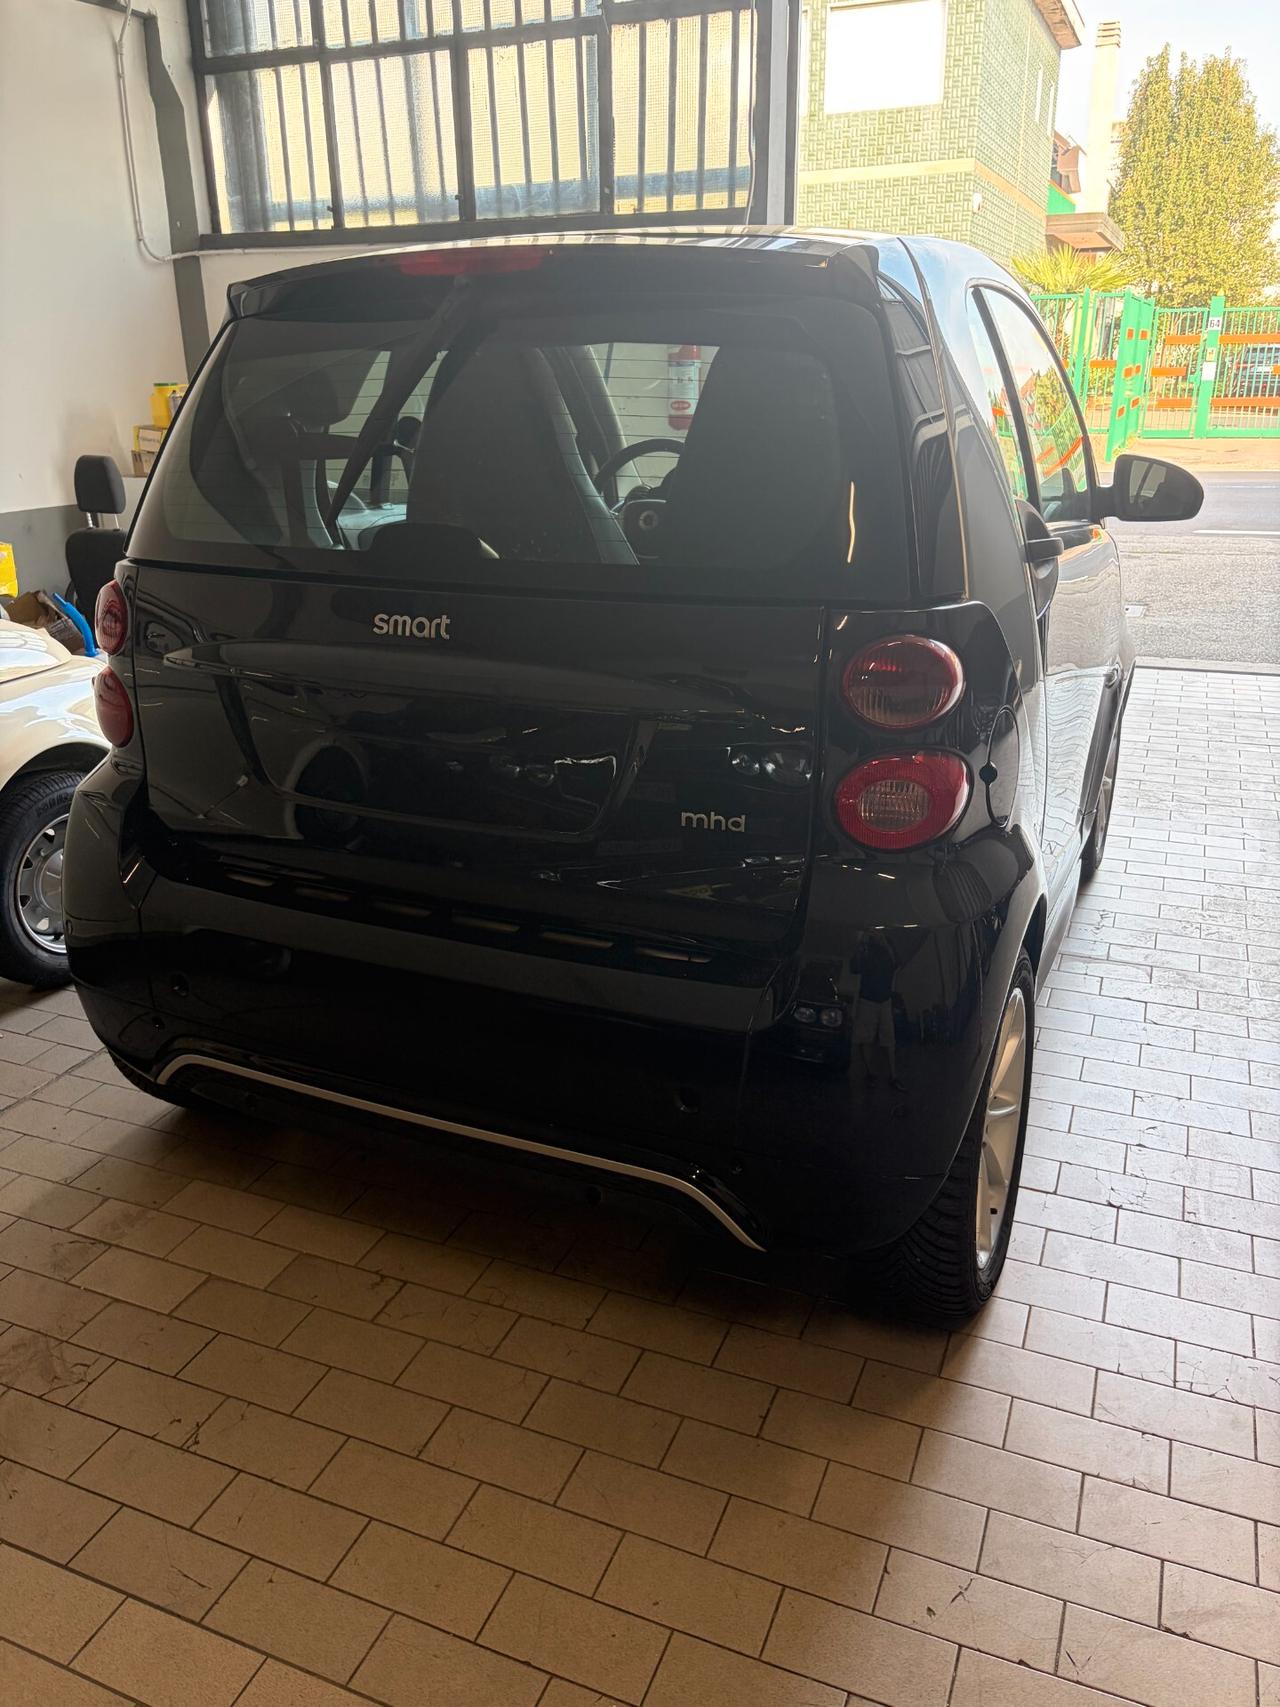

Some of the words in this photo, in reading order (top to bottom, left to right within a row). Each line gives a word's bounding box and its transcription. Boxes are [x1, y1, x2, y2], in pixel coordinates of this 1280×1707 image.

[1210, 319, 1220, 328] 64
[372, 613, 451, 640] smart
[680, 811, 746, 832] mhd
